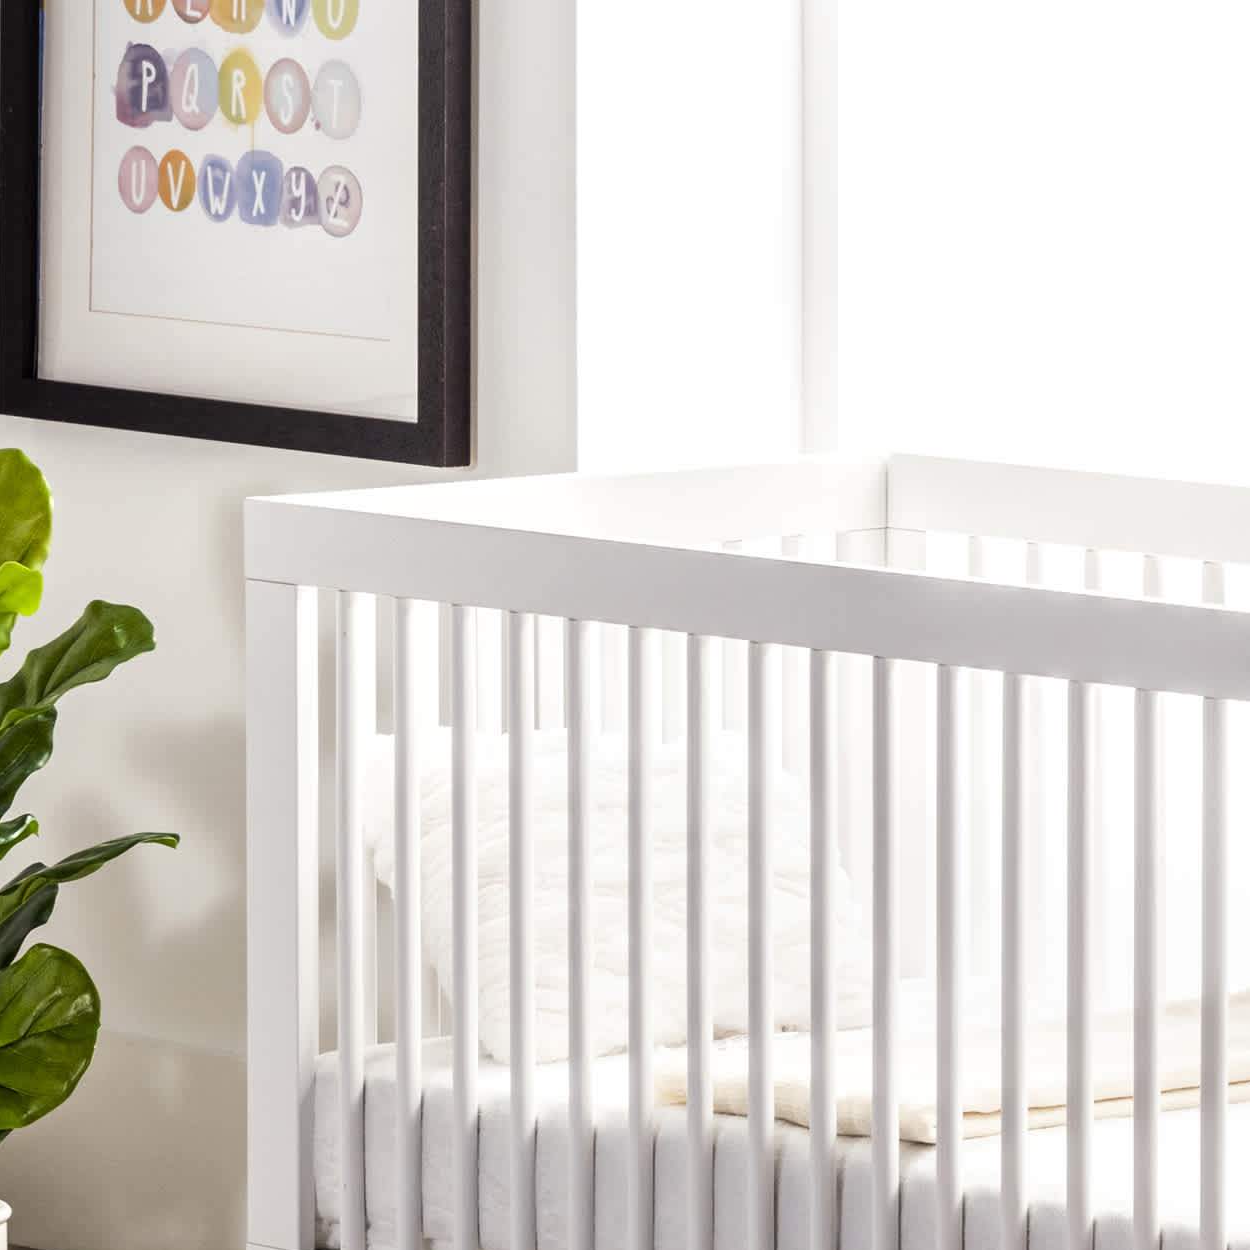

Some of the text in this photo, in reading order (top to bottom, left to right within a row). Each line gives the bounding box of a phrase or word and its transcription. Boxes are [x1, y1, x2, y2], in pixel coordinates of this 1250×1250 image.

[142, 60, 343, 129] P Q R S T
[131, 159, 147, 206] U
[166, 160, 186, 209] V
[207, 165, 231, 215] W
[251, 170, 266, 217] X
[328, 174, 349, 227] Z
